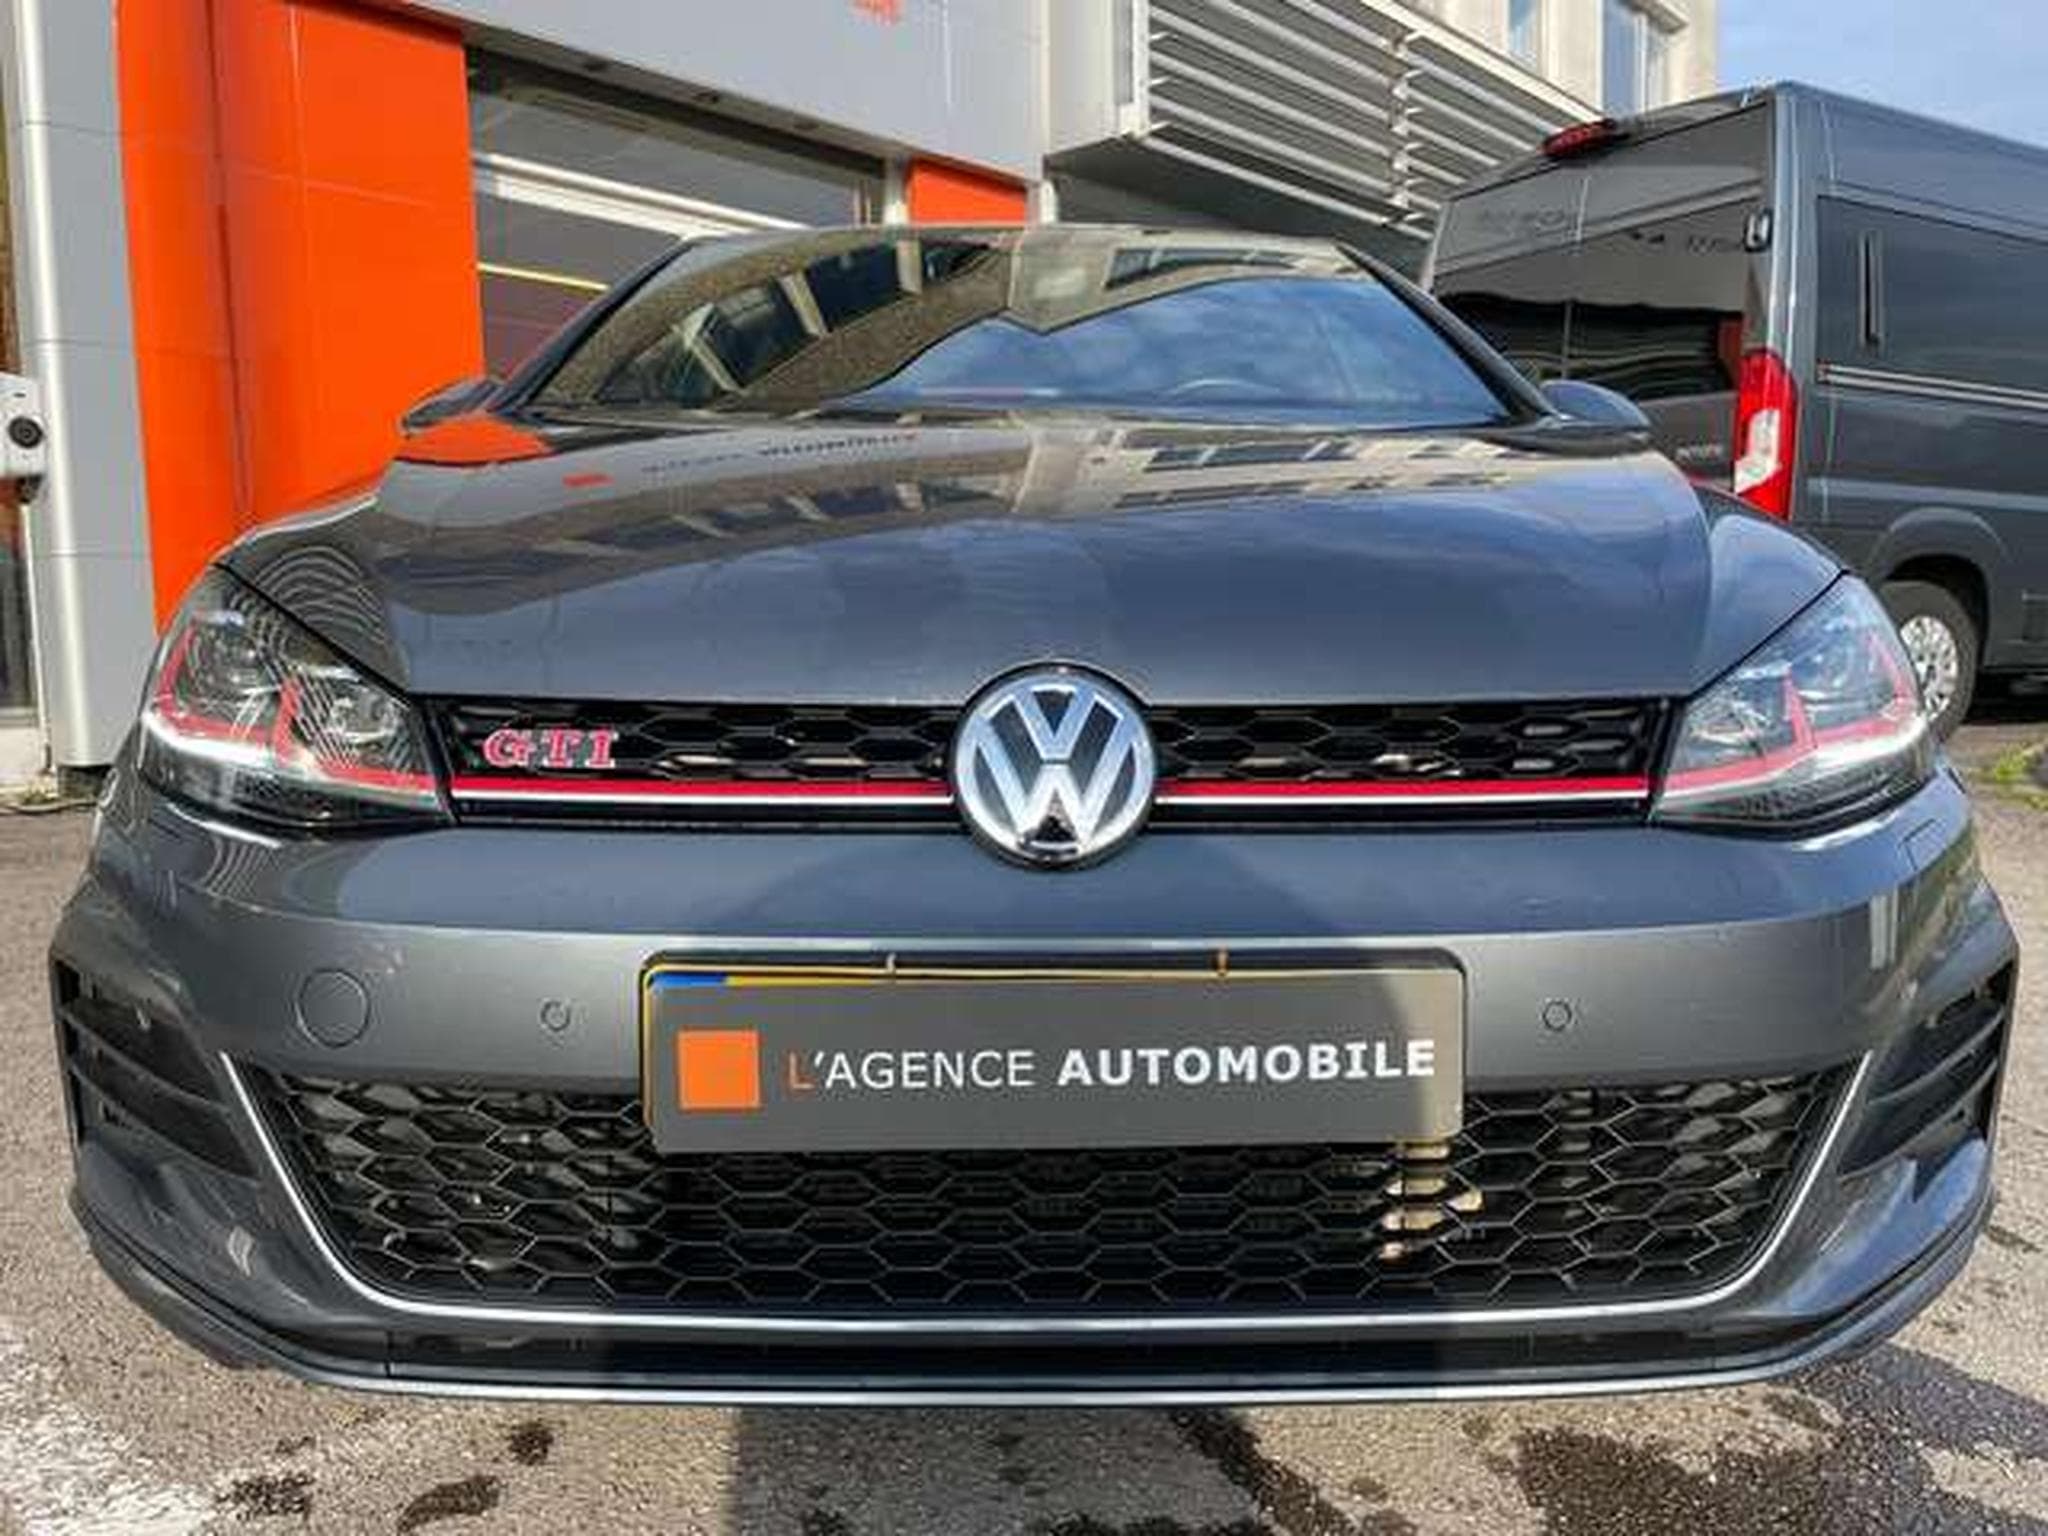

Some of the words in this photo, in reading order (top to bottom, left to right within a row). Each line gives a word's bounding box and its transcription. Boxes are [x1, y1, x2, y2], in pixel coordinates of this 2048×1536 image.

[483, 728, 619, 769] GTI
[788, 1049, 1036, 1090] L'AGENCE
[1057, 1039, 1435, 1087] AUTOMOBILE
